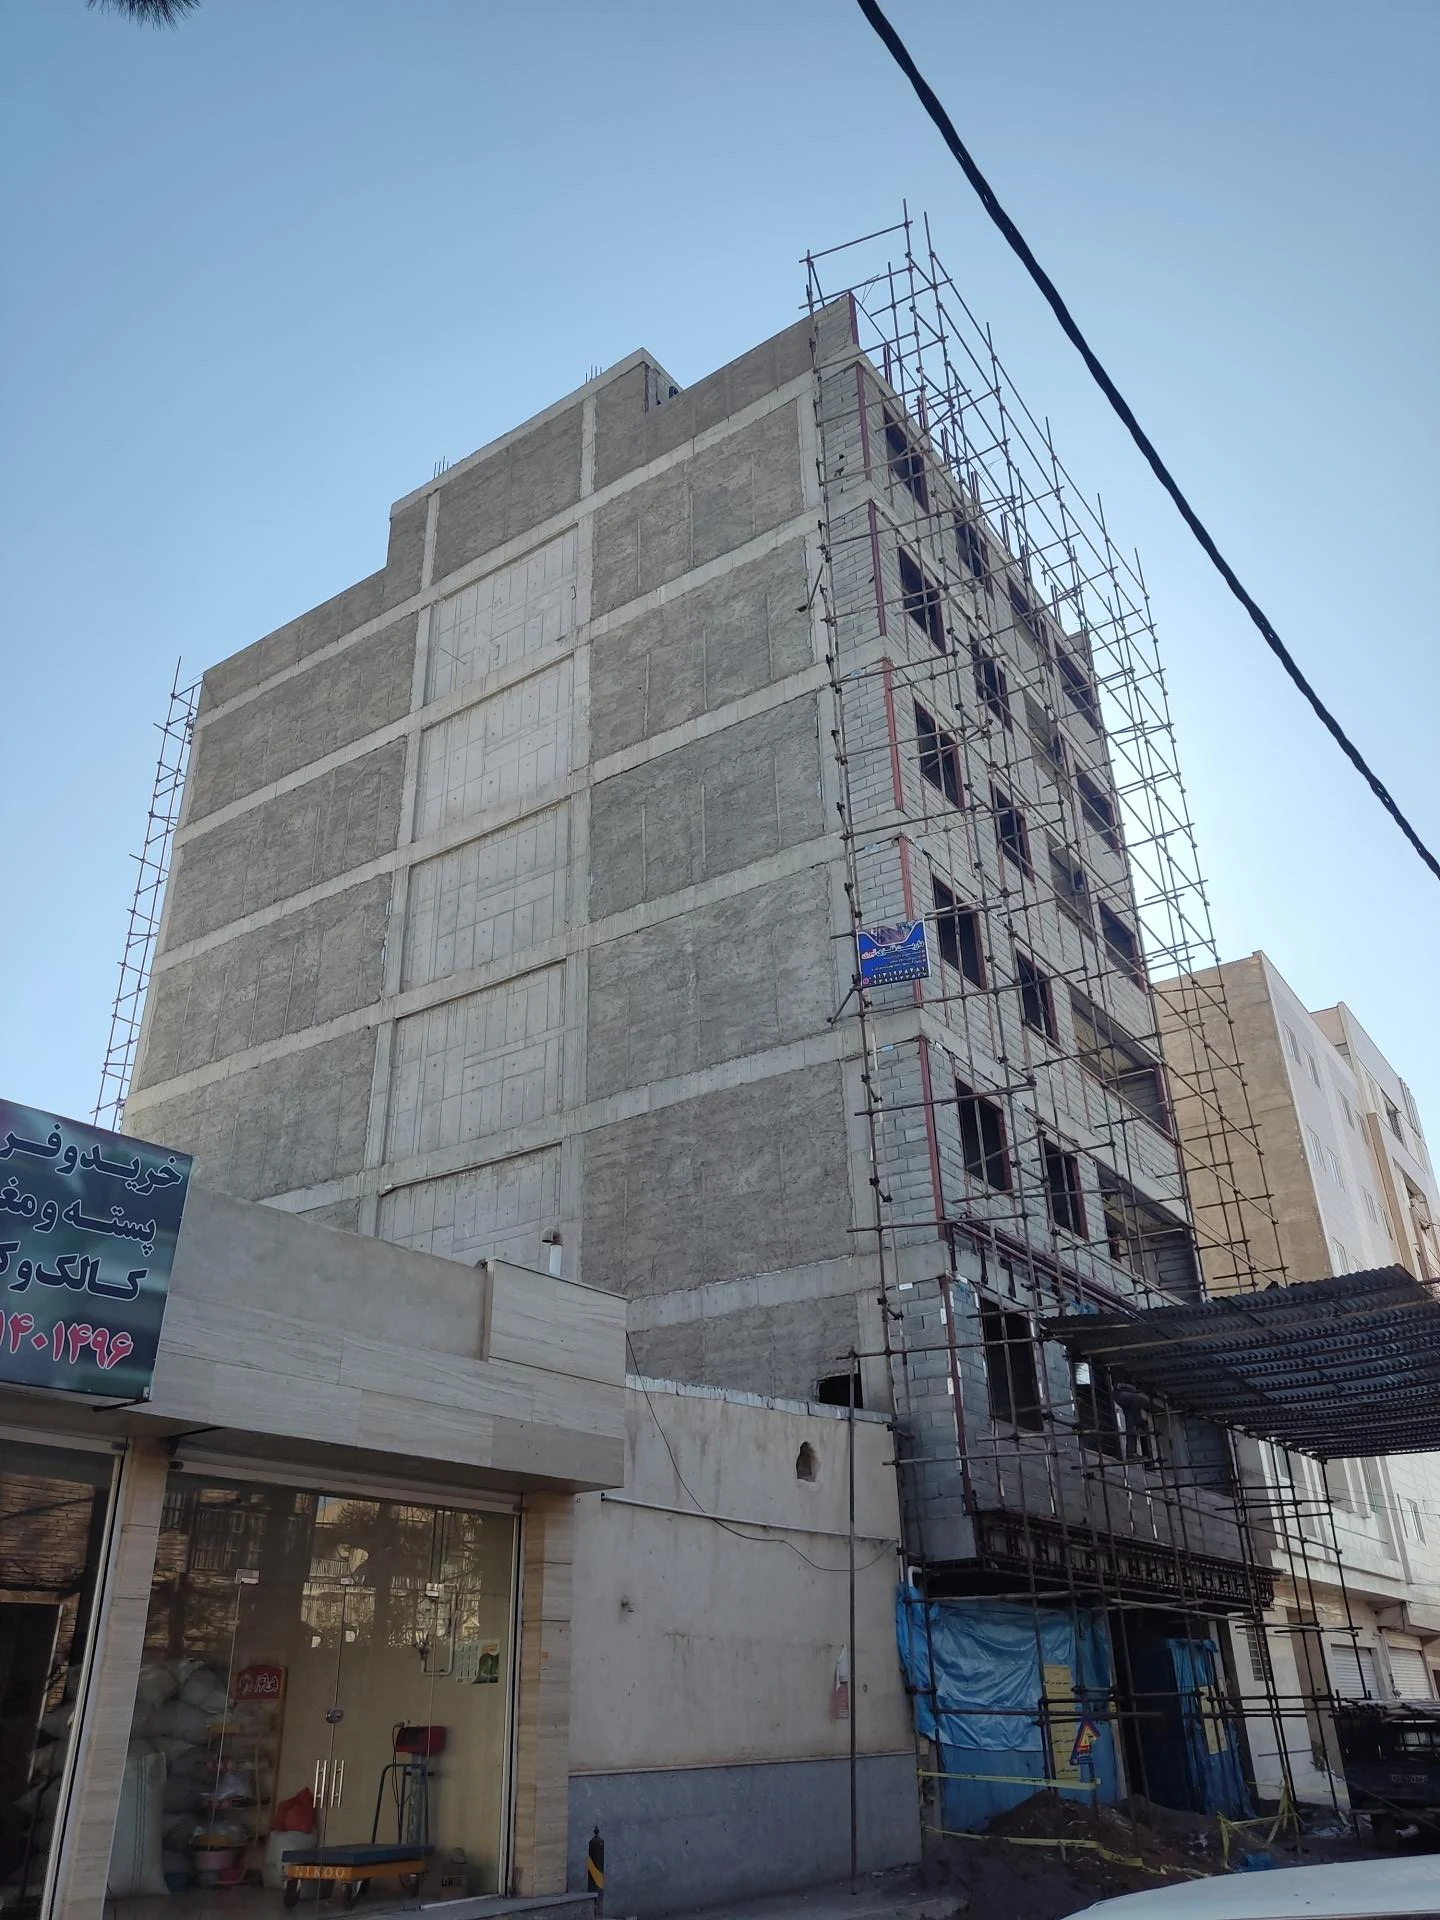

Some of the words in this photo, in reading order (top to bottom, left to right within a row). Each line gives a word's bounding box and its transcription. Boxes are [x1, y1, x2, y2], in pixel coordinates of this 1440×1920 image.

[55, 1145, 79, 1175] و
[79, 1144, 183, 1196] خرید
[33, 1200, 58, 1233] و
[62, 1199, 157, 1257] پسته
[8, 1259, 33, 1293] و
[35, 1254, 149, 1300] کالک
[294, 1865, 345, 1880] NIKOO
